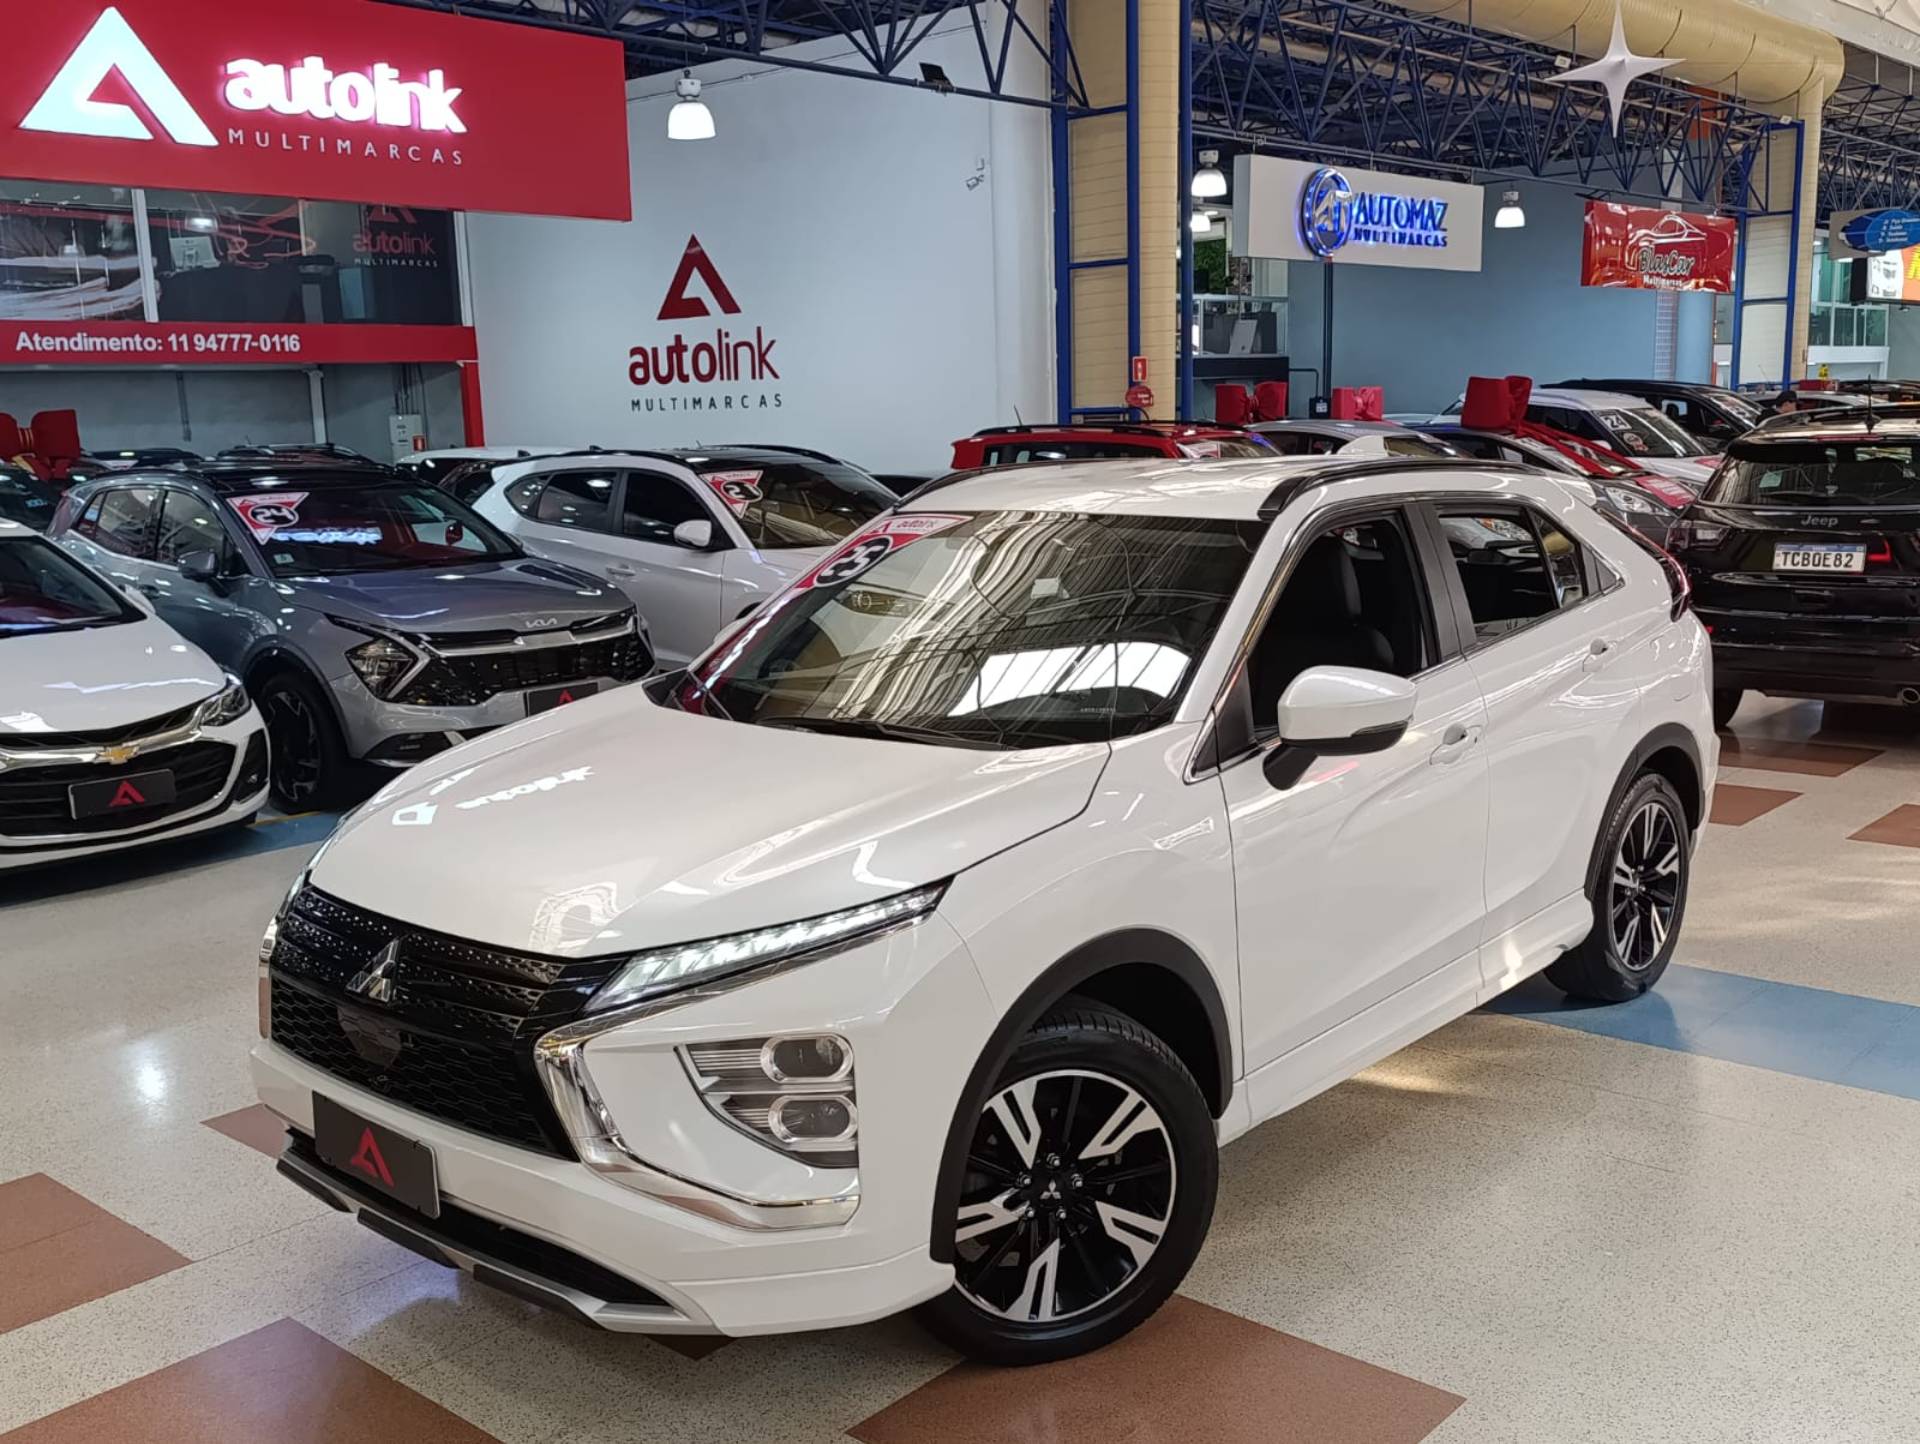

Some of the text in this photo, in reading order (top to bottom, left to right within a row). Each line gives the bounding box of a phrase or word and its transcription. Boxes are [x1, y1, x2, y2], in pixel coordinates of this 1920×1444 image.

[224, 56, 468, 133] autolink
[228, 128, 463, 165] MULTIMARCAS
[1355, 191, 1448, 231] AUTOMAZ
[352, 231, 436, 255] autolink
[1353, 227, 1448, 247] MULTIMARCAS
[353, 258, 438, 268] MULTIMARCAS
[15, 331, 301, 352] Atendimento: 11 94777-0116
[628, 326, 781, 386] autolink
[631, 393, 783, 412] MULTIMARCAS
[254, 507, 295, 523] 24
[1801, 514, 1839, 527] Jeep
[820, 544, 885, 577] 25
